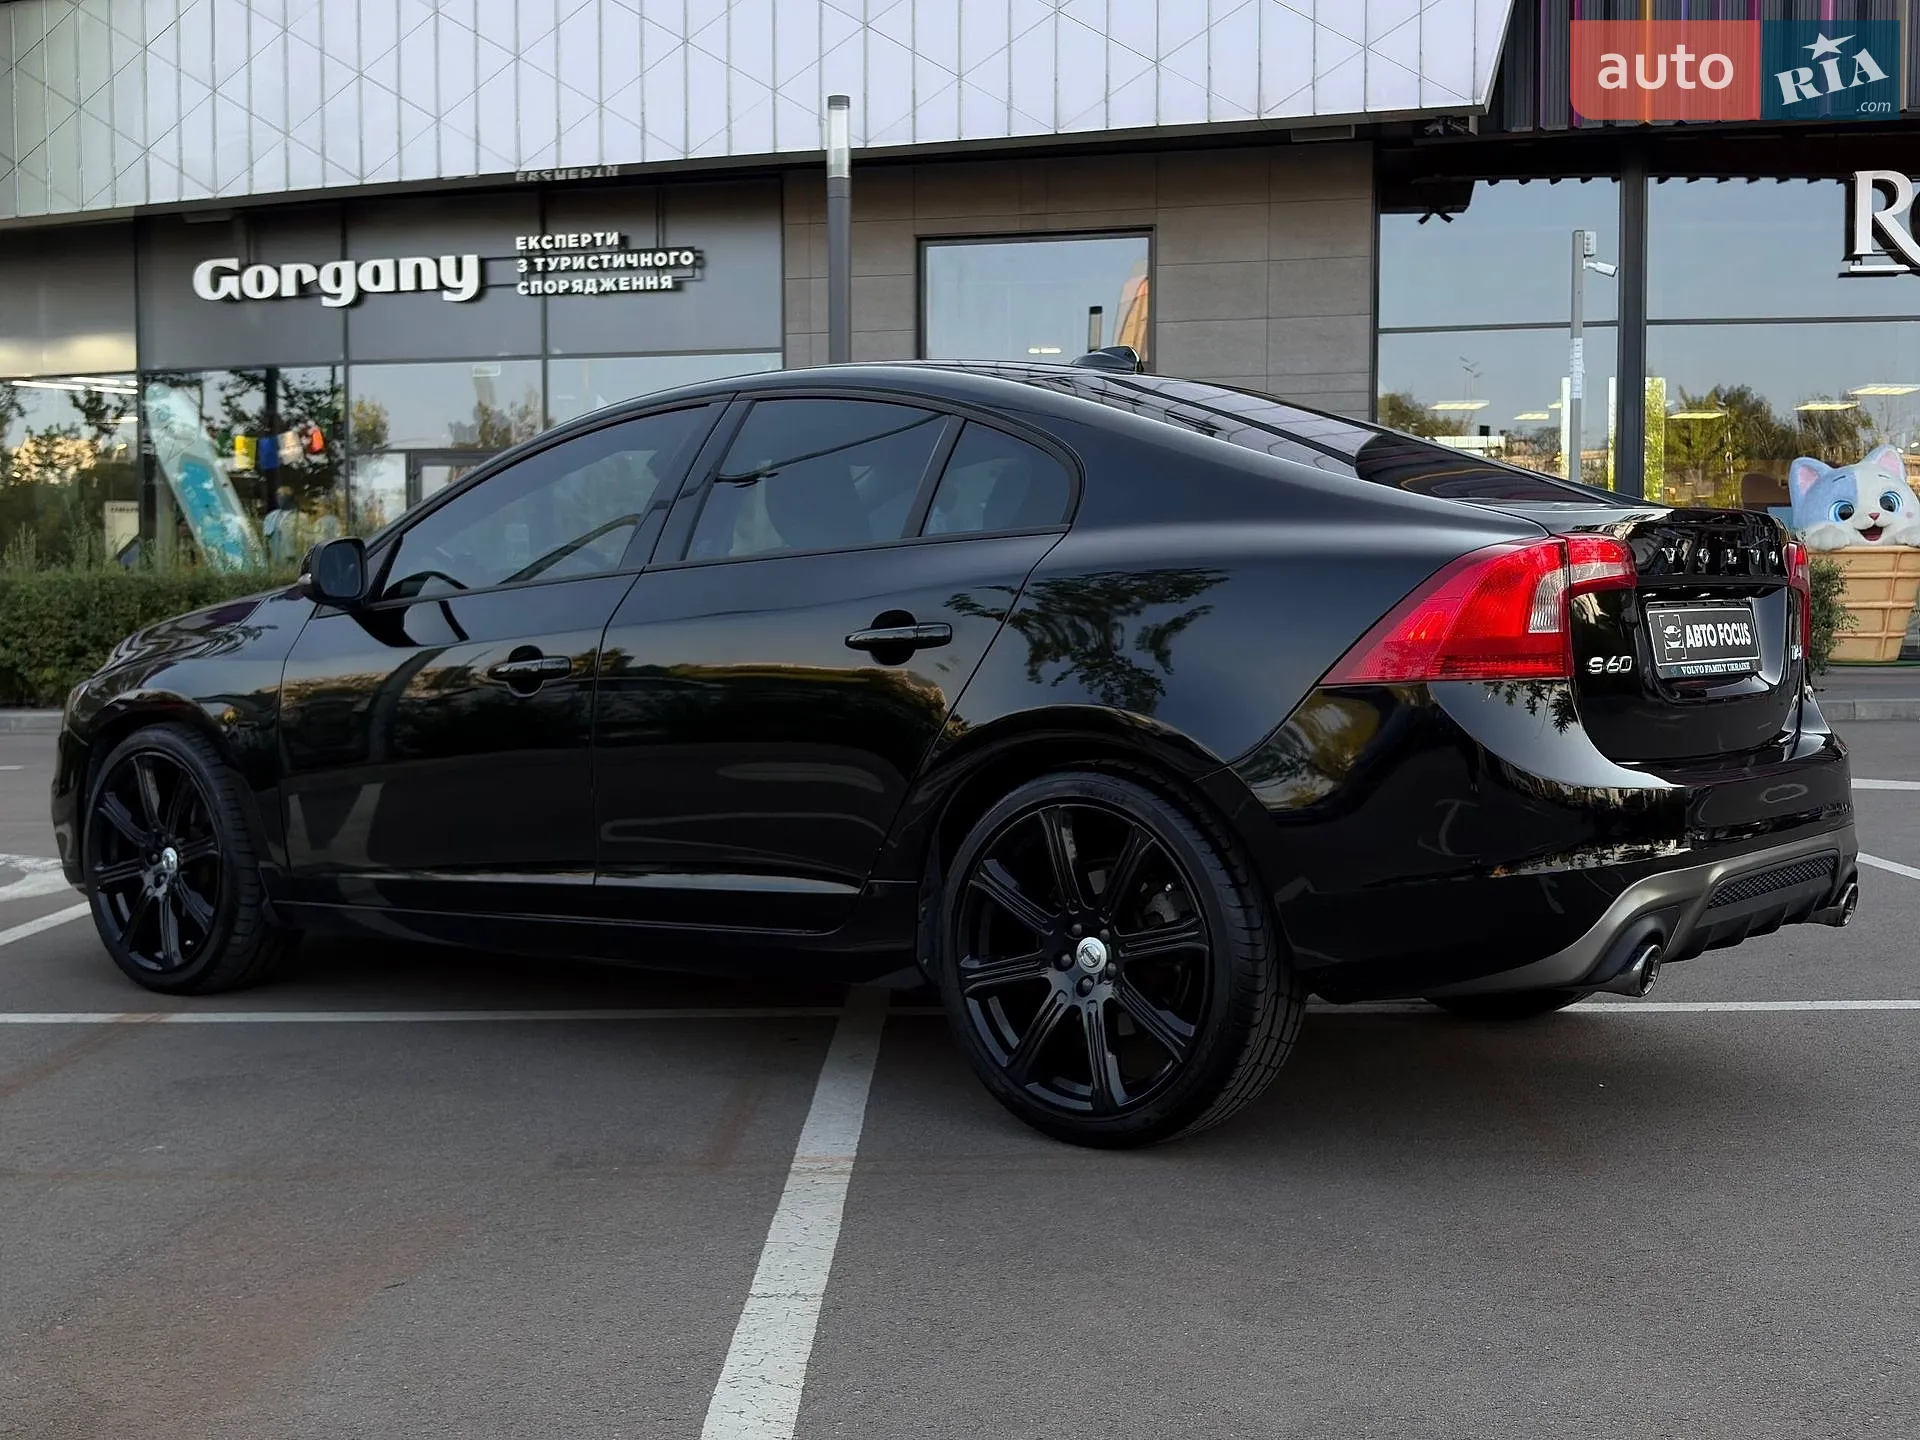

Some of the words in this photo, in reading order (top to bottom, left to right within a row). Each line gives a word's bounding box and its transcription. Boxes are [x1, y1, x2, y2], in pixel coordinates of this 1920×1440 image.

[515, 232, 620, 250] ЕКСПЕРТИ
[534, 251, 695, 272] ТУРИСТИЧНОГО
[193, 254, 480, 308] Gorgany
[517, 275, 673, 296] СПОРЯДЖЕННЯ
[1660, 547, 1780, 565] VOLVO
[1686, 624, 1717, 648] АВТО
[1717, 622, 1751, 647] FOCUS
[1588, 655, 1633, 674] S60
[1680, 665, 1705, 675] VOLVO
[1704, 663, 1728, 674] FAMILY
[1727, 661, 1751, 672] UKRAINE
